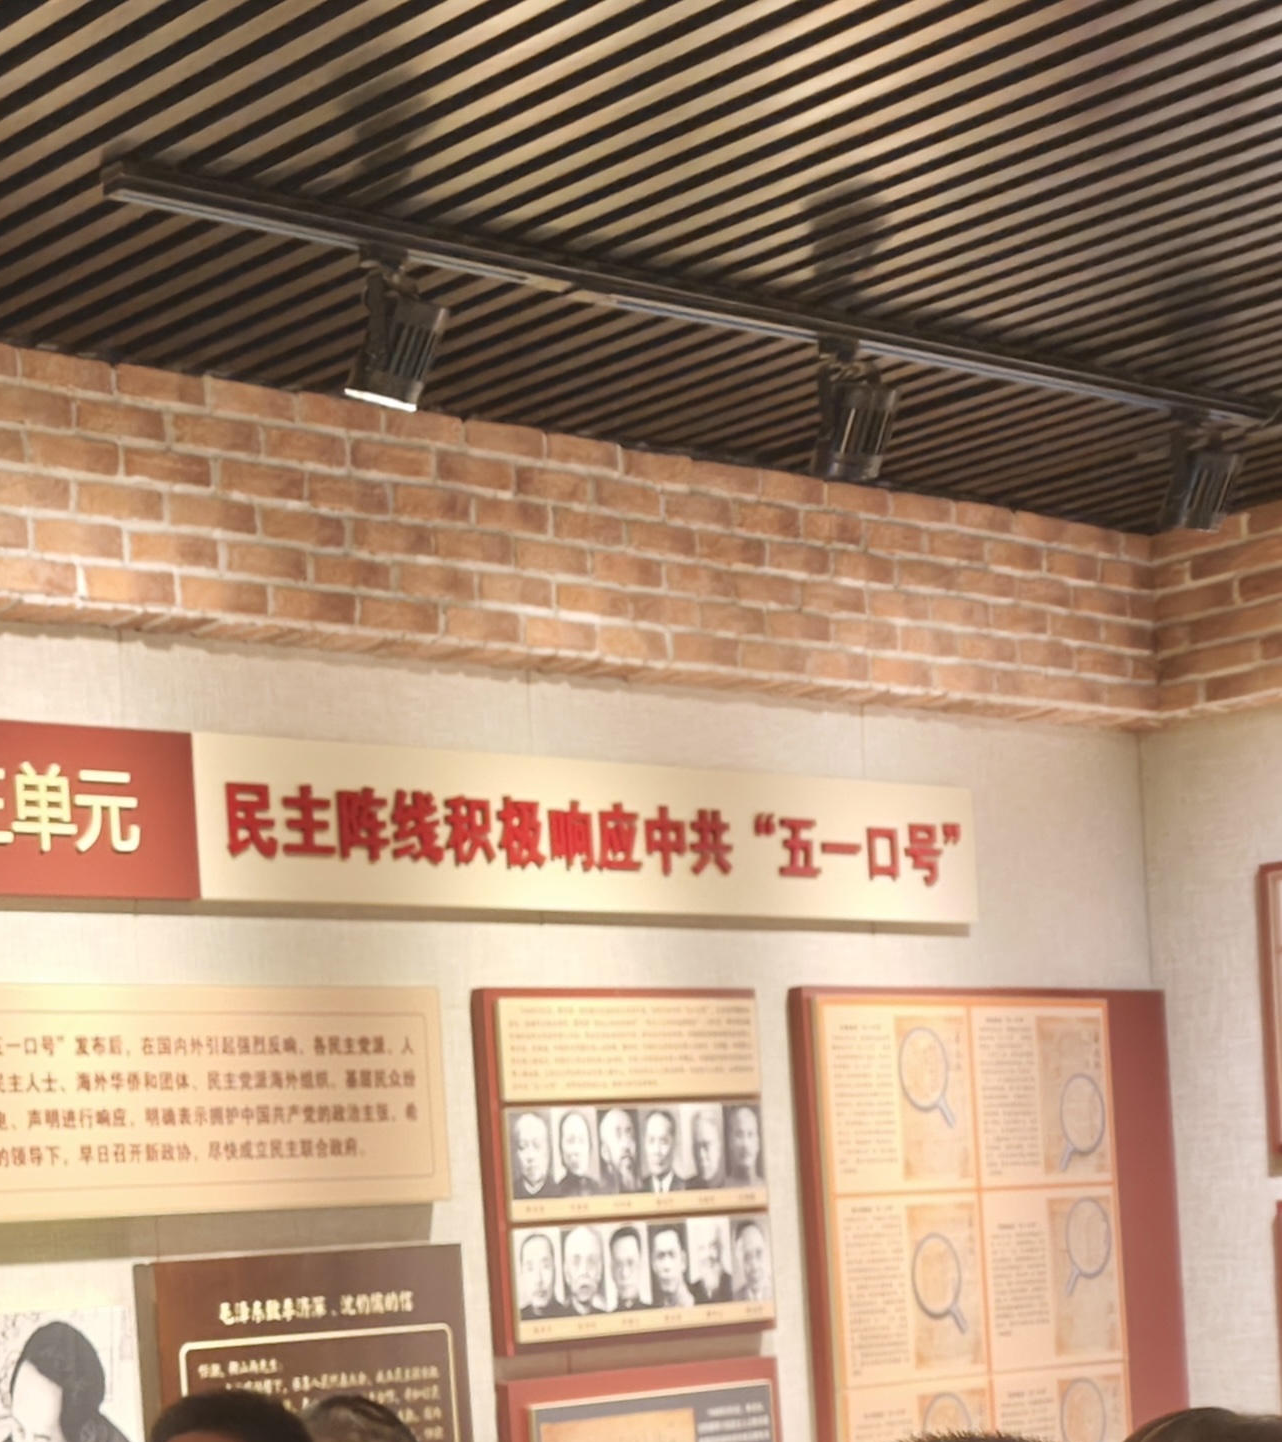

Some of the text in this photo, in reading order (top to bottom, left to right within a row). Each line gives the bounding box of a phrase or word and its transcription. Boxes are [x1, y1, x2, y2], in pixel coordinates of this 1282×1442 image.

[225, 782, 961, 887] 民主阵线积极响应中共“五一口号”
